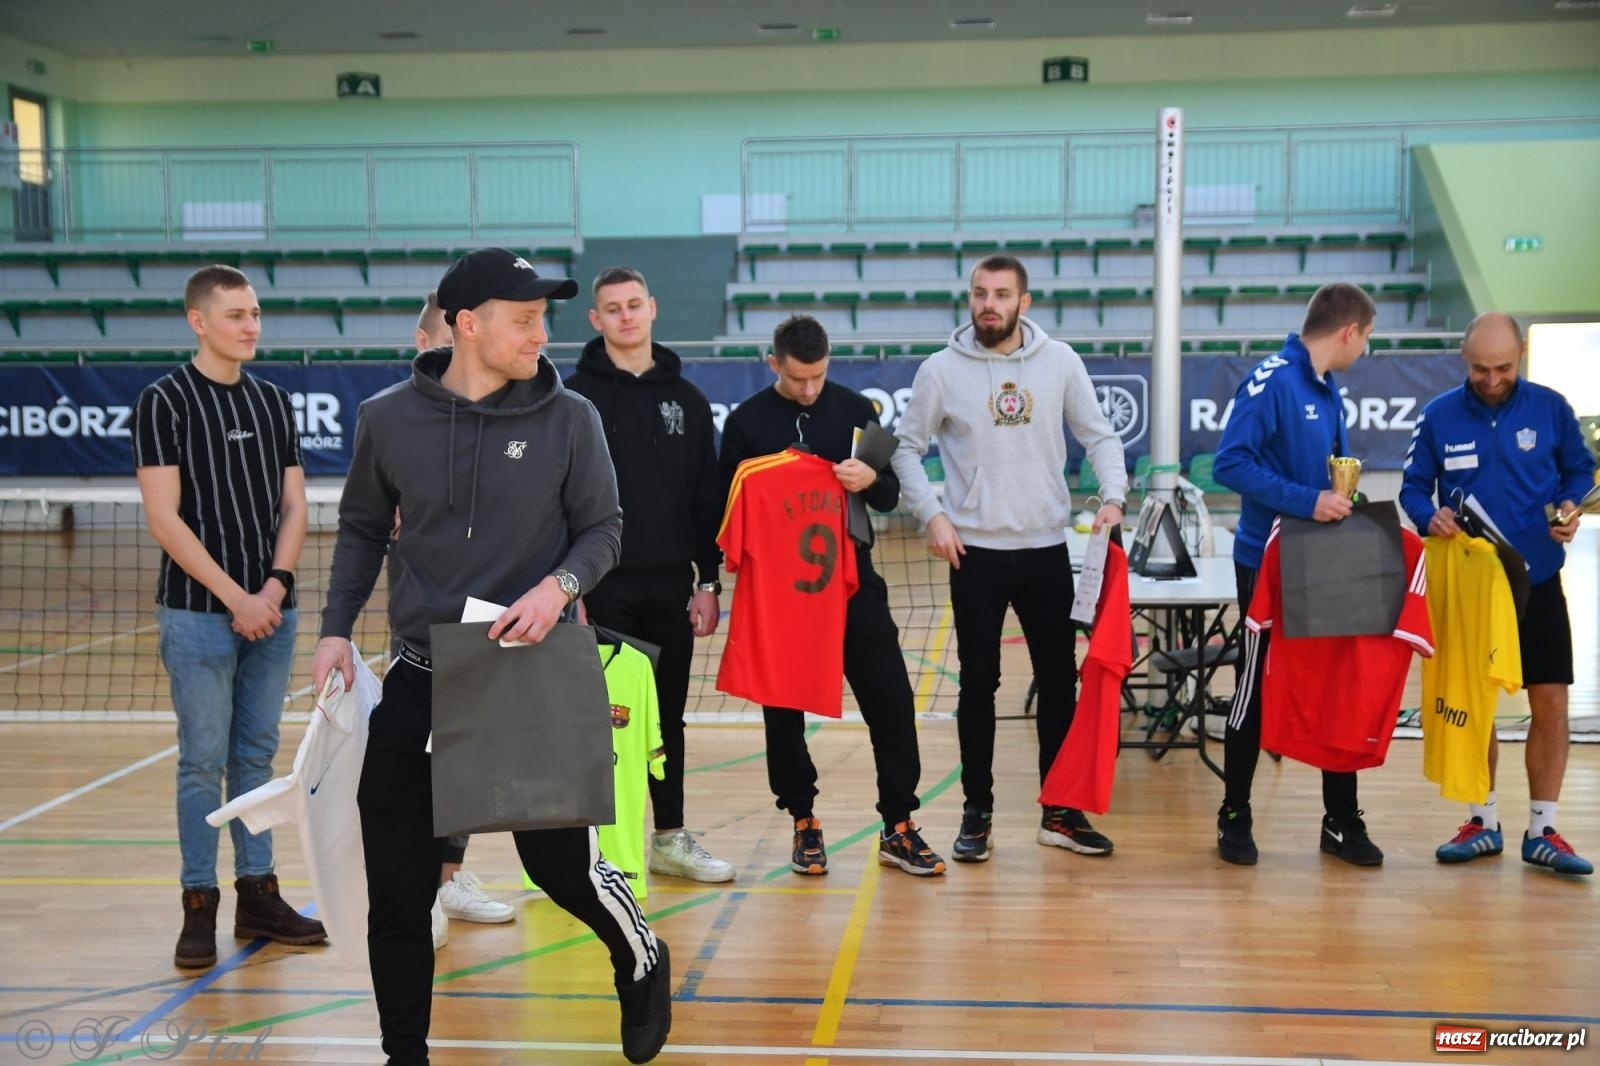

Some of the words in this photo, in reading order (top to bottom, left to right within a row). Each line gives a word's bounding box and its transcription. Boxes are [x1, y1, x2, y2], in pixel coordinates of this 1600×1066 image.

[1070, 63, 1084, 79] B
[356, 79, 377, 97] A
[794, 522, 837, 594] 9
